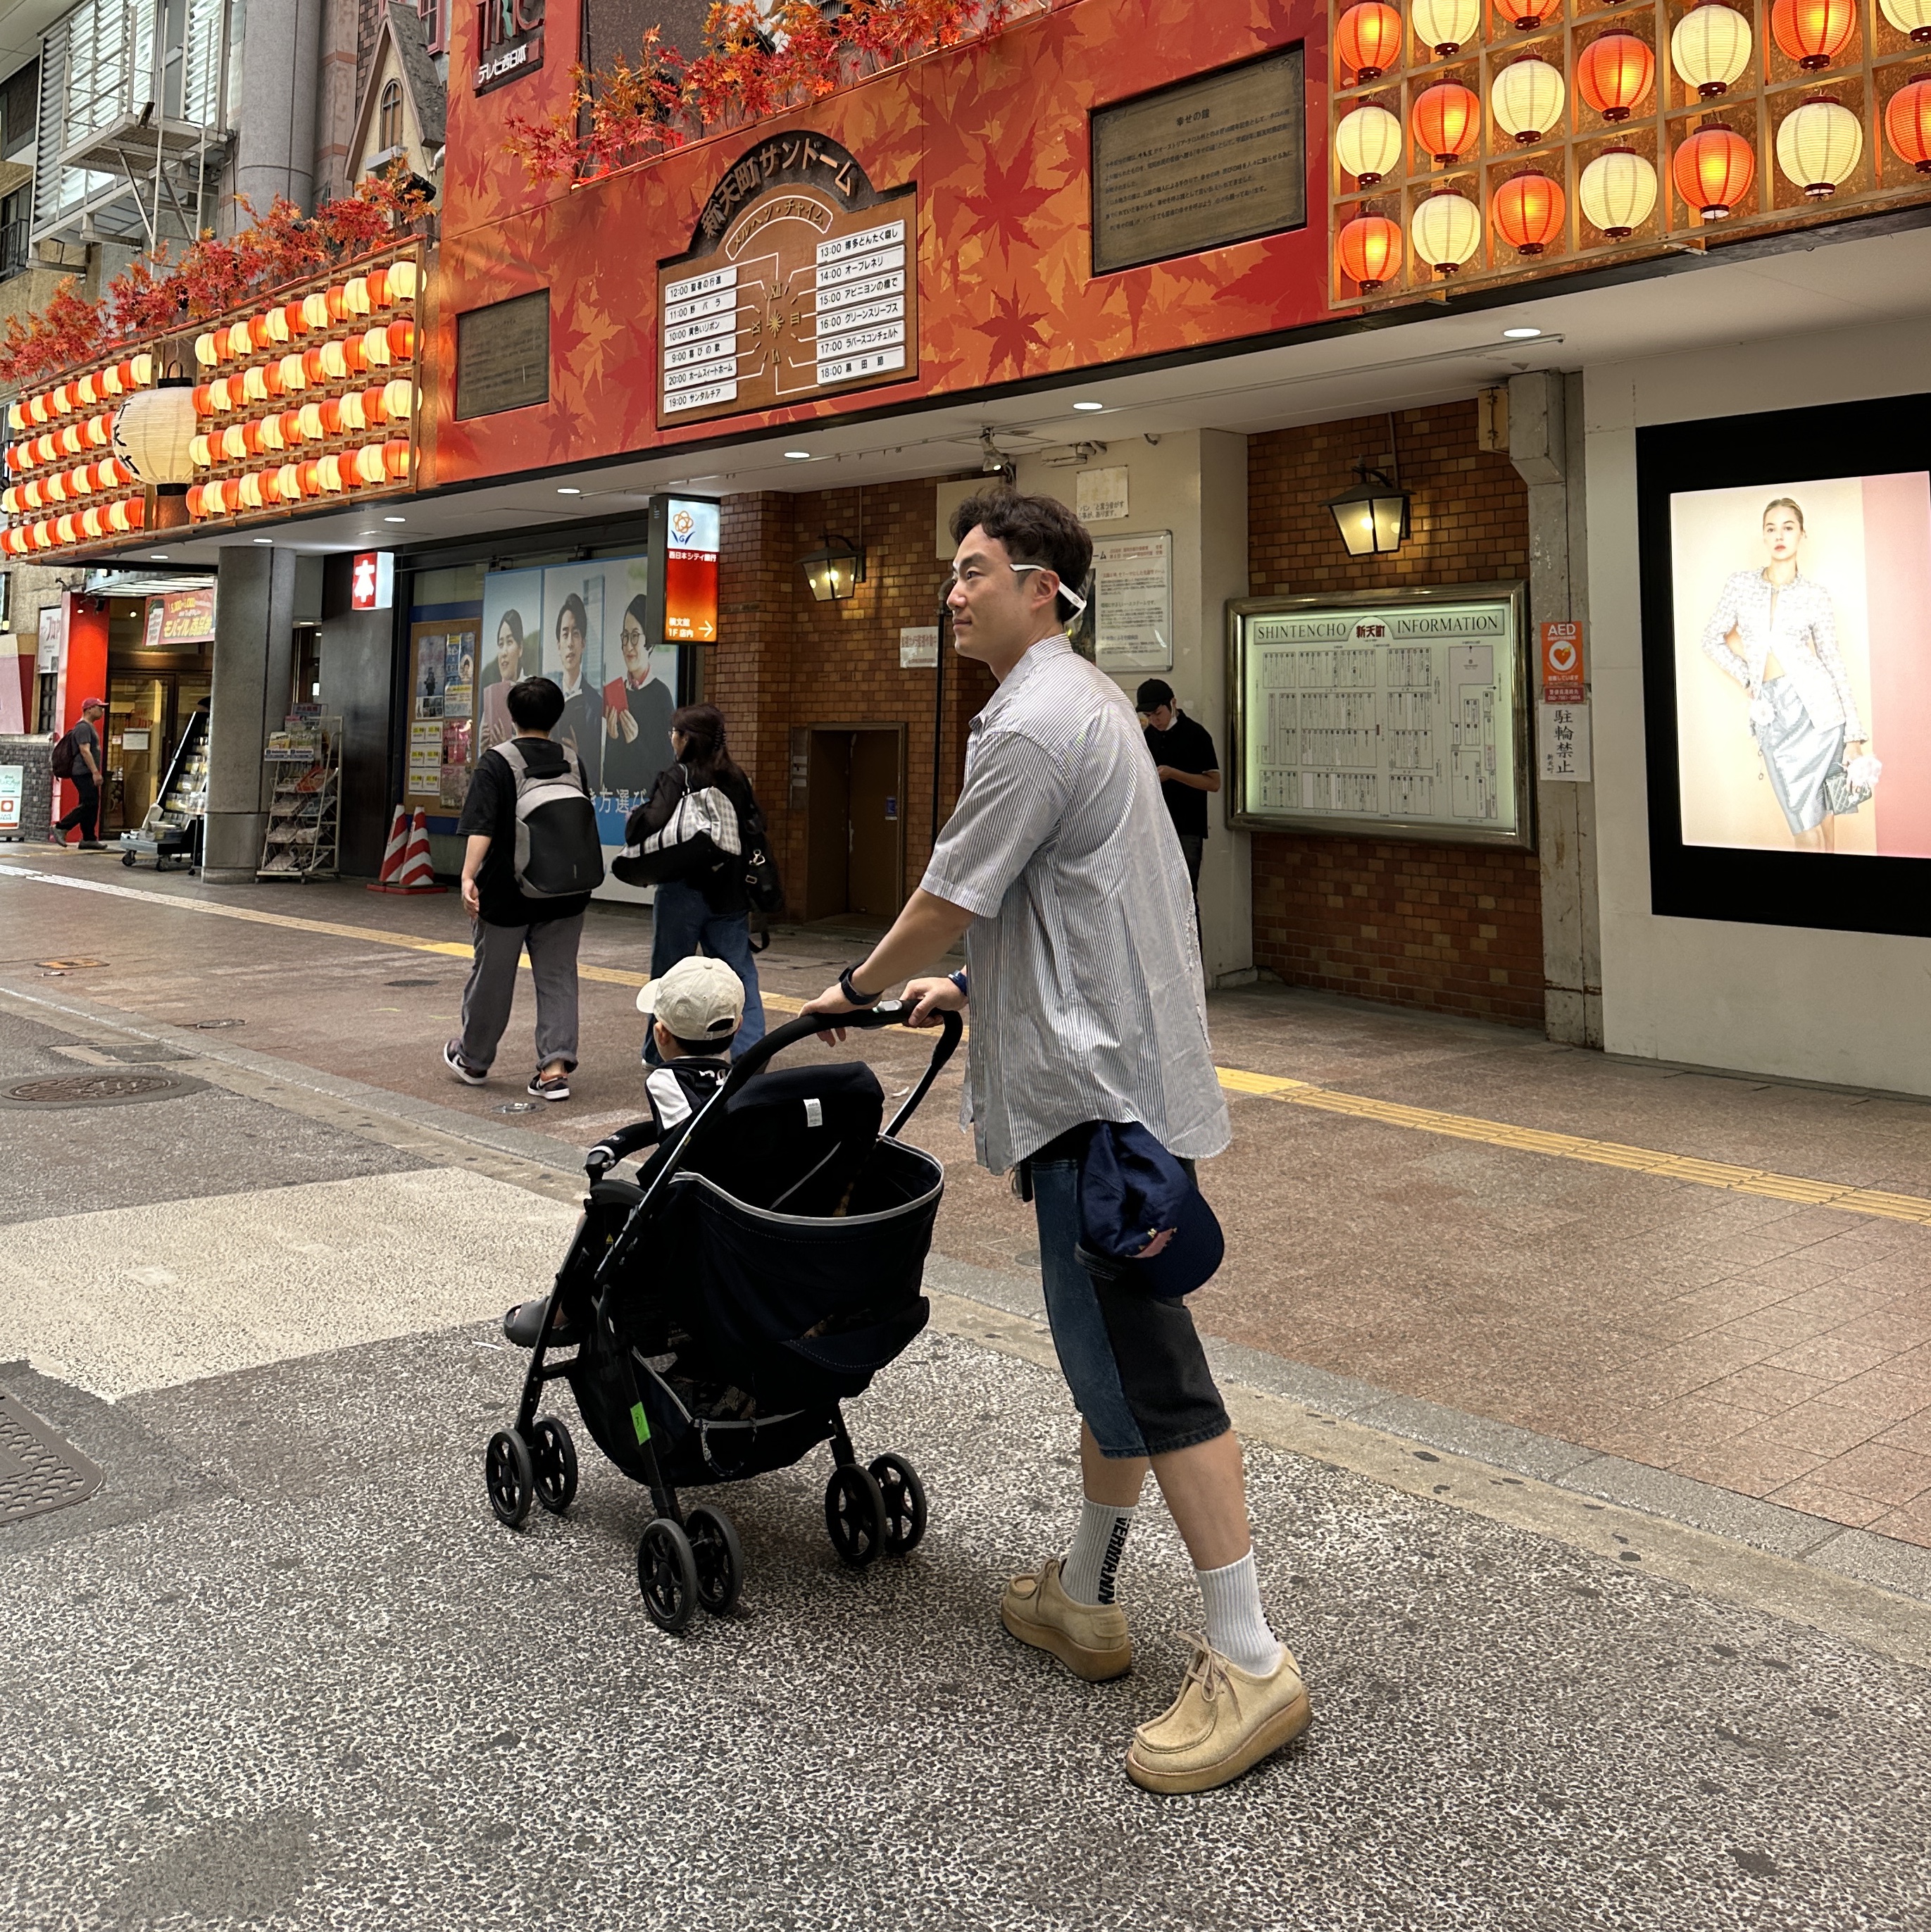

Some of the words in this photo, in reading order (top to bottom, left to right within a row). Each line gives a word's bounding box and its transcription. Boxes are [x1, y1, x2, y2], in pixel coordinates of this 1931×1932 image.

[479, 44, 527, 83] テレビ西日本
[1177, 108, 1210, 126] 幸せの鐘
[701, 138, 854, 239] 新天町サンドーム
[734, 199, 824, 252] メルヘン・チャイム
[820, 243, 842, 257] 13:00
[820, 267, 842, 282] 14:00
[670, 285, 688, 298] 12:00
[820, 292, 841, 306] 15:00
[670, 307, 688, 320] 11:00
[820, 316, 842, 330] 16:00
[669, 329, 687, 342] 10:00
[689, 321, 720, 336] 黄色いリボン
[820, 340, 842, 354] 17:00
[846, 328, 898, 349] ラバースコンチェルト
[672, 351, 687, 363] 9:00
[820, 365, 842, 379] 18:00
[669, 373, 687, 386] 20:00
[669, 395, 687, 408] 19:00
[689, 388, 721, 404] サンタルチア
[669, 551, 717, 562] 西日本シティ銀行
[1258, 623, 1346, 639] SHINTENCHO
[1397, 616, 1498, 633] INFORMATION
[1548, 623, 1576, 636] AED
[668, 628, 678, 637] 1F
[680, 628, 694, 638] 店内
[1356, 625, 1385, 639] 新天町
[1554, 709, 1575, 773] 駐輪禁止
